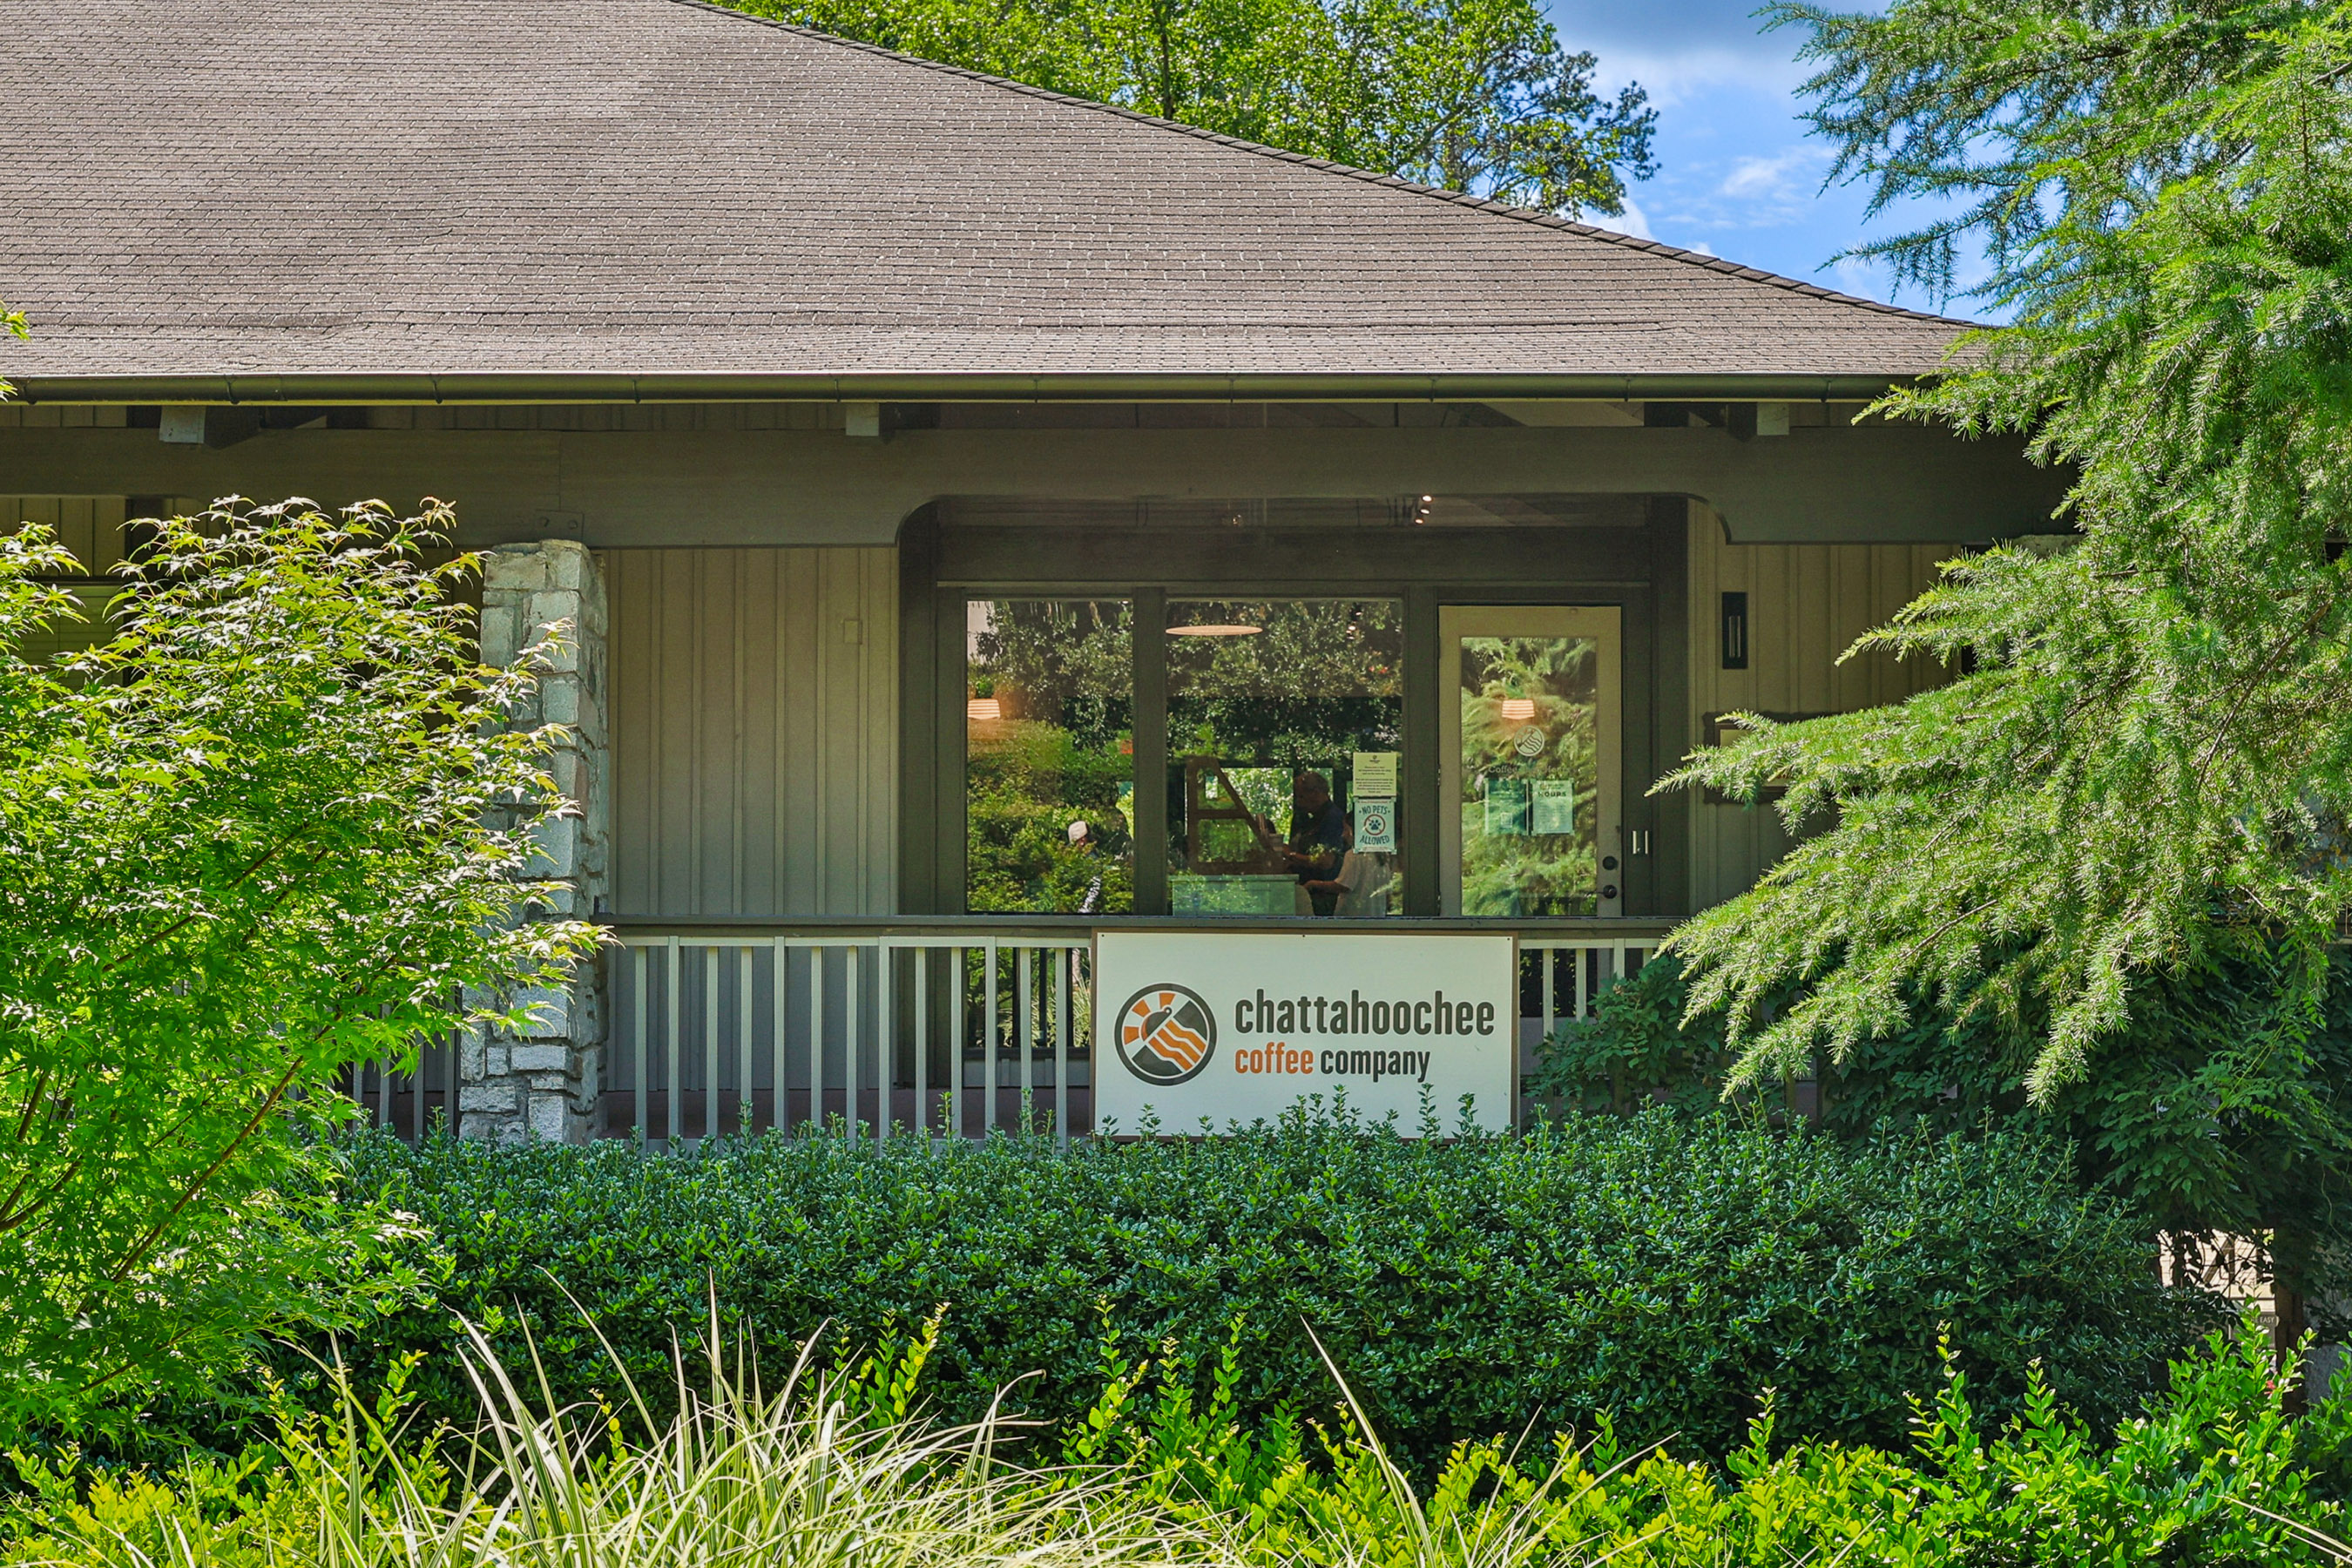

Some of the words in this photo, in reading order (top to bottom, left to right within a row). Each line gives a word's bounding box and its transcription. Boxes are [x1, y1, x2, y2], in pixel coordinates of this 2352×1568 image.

[1362, 806, 1371, 814] NO
[1373, 806, 1387, 814] PETS
[1360, 835, 1389, 844] ALLOWED
[1235, 989, 1495, 1036] chattahoochee
[1235, 1042, 1314, 1074] coffee
[1321, 1049, 1430, 1083] company
